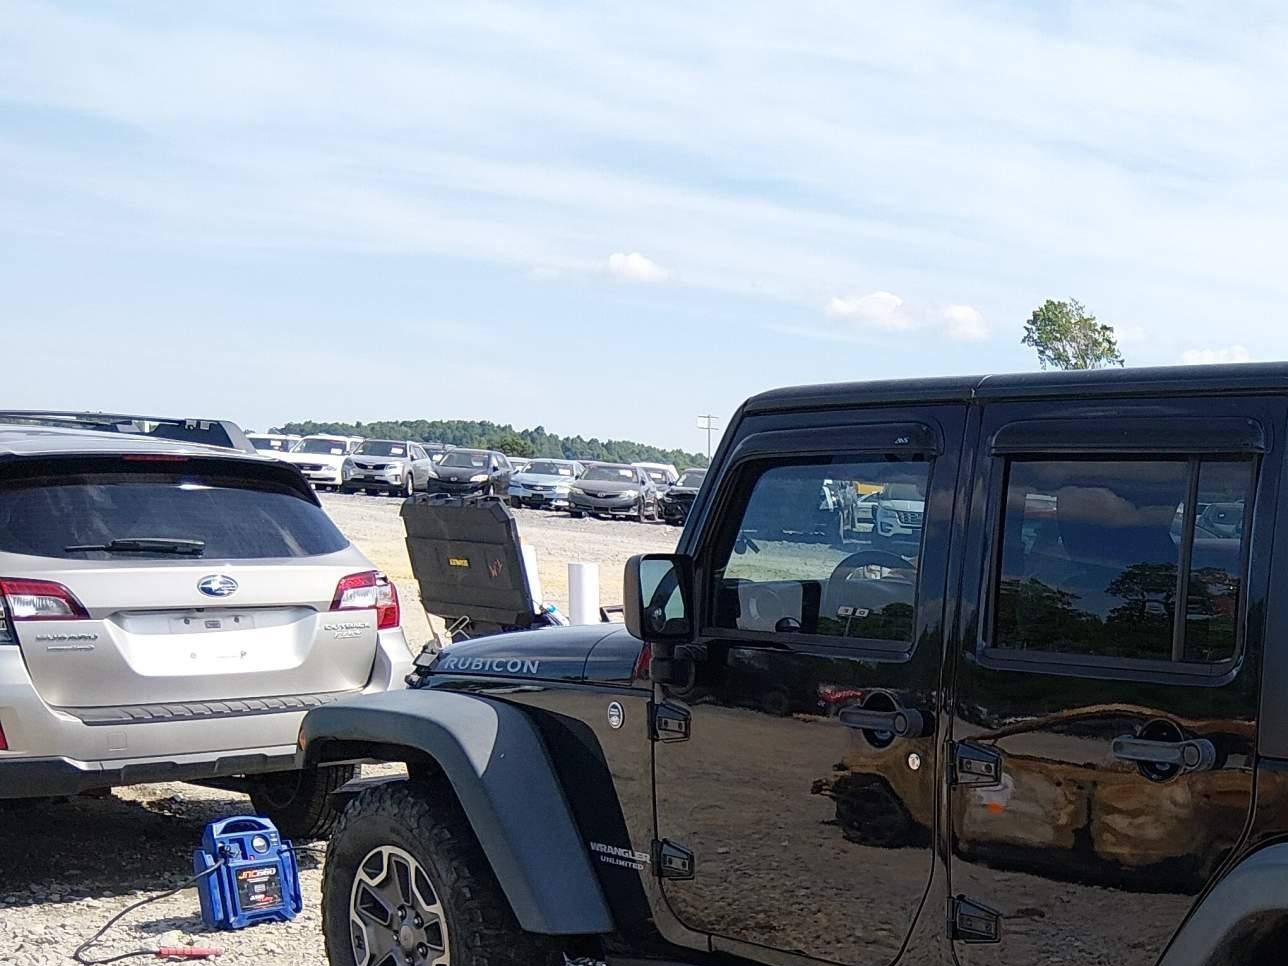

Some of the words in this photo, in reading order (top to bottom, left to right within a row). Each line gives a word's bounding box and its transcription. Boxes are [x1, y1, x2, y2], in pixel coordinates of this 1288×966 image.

[444, 657, 540, 674] RUBICON
[590, 841, 651, 864] WRANGLER
[600, 855, 644, 871] UNLIMITED
